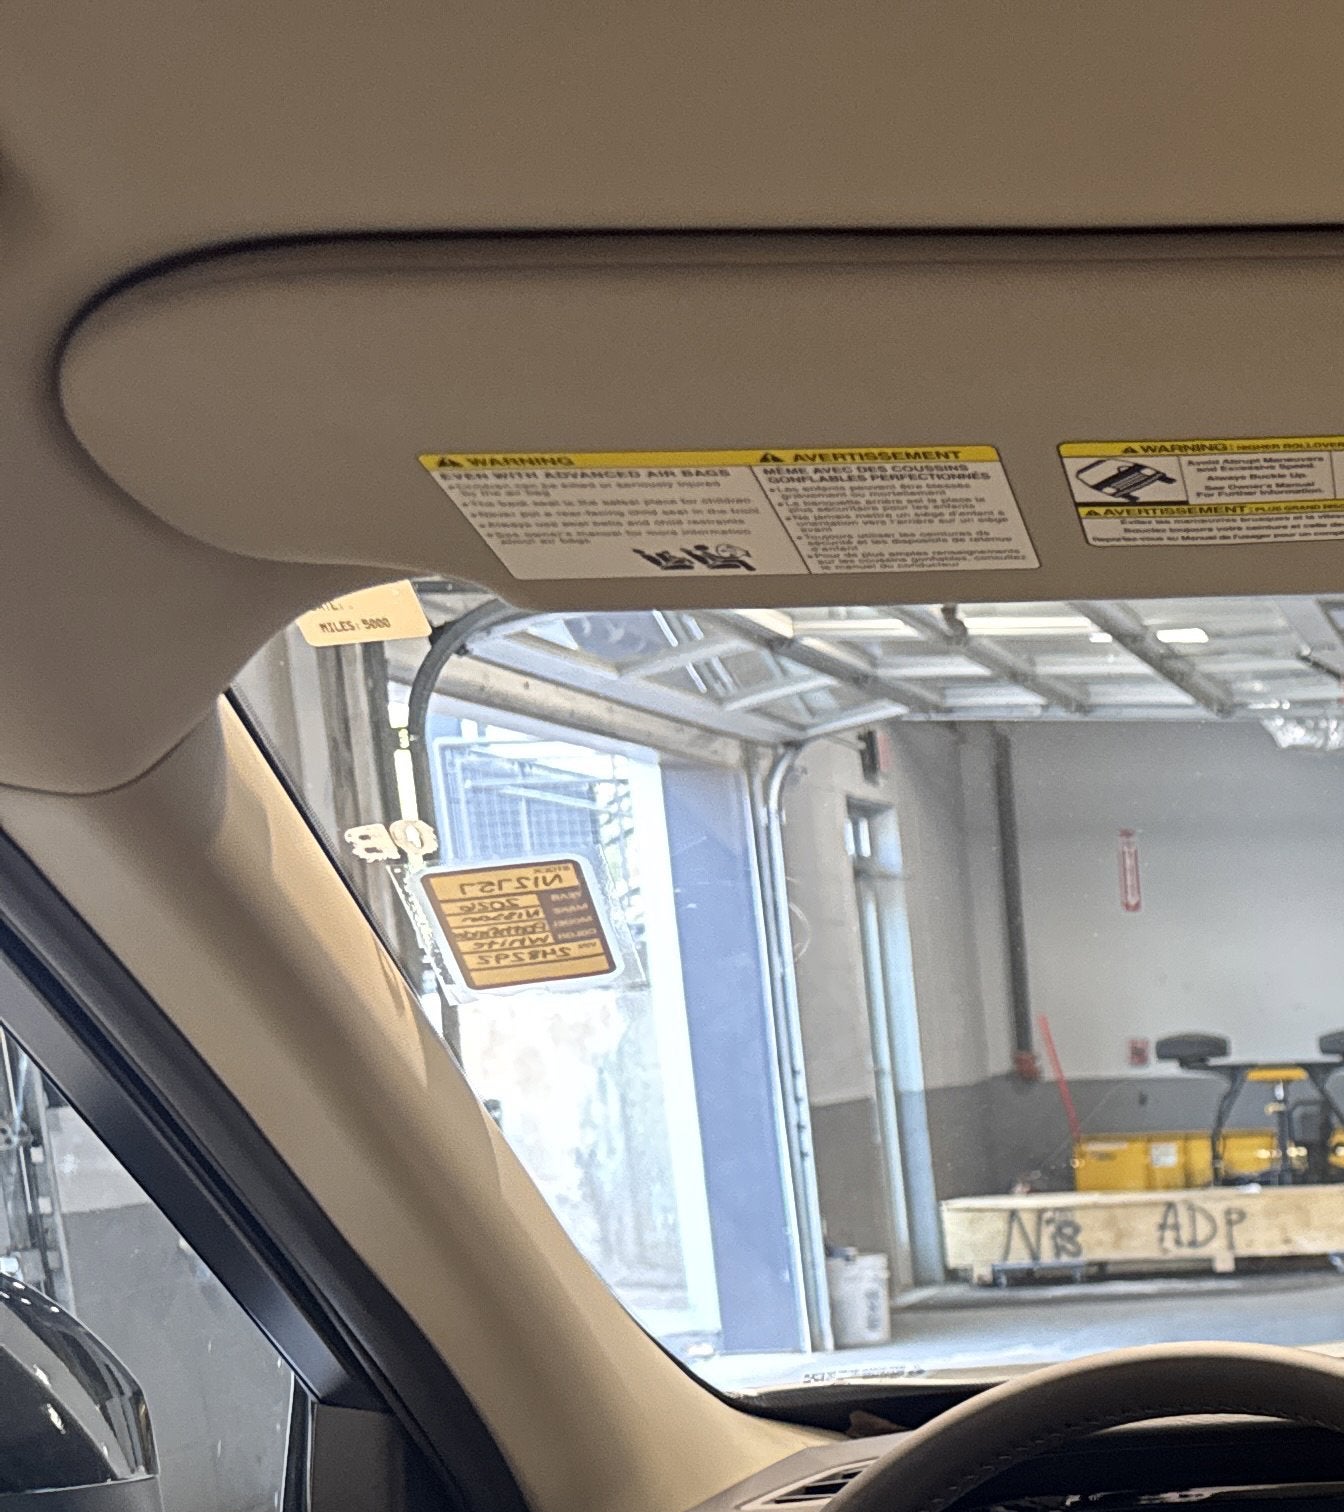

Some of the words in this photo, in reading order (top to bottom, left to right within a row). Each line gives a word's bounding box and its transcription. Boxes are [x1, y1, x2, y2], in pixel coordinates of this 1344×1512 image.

[466, 457, 575, 466] WARNING
[793, 451, 962, 462] AVERTISSEMENT
[439, 472, 489, 480] EVEN
[492, 472, 538, 480] WITH
[544, 470, 641, 479] ADVANCED
